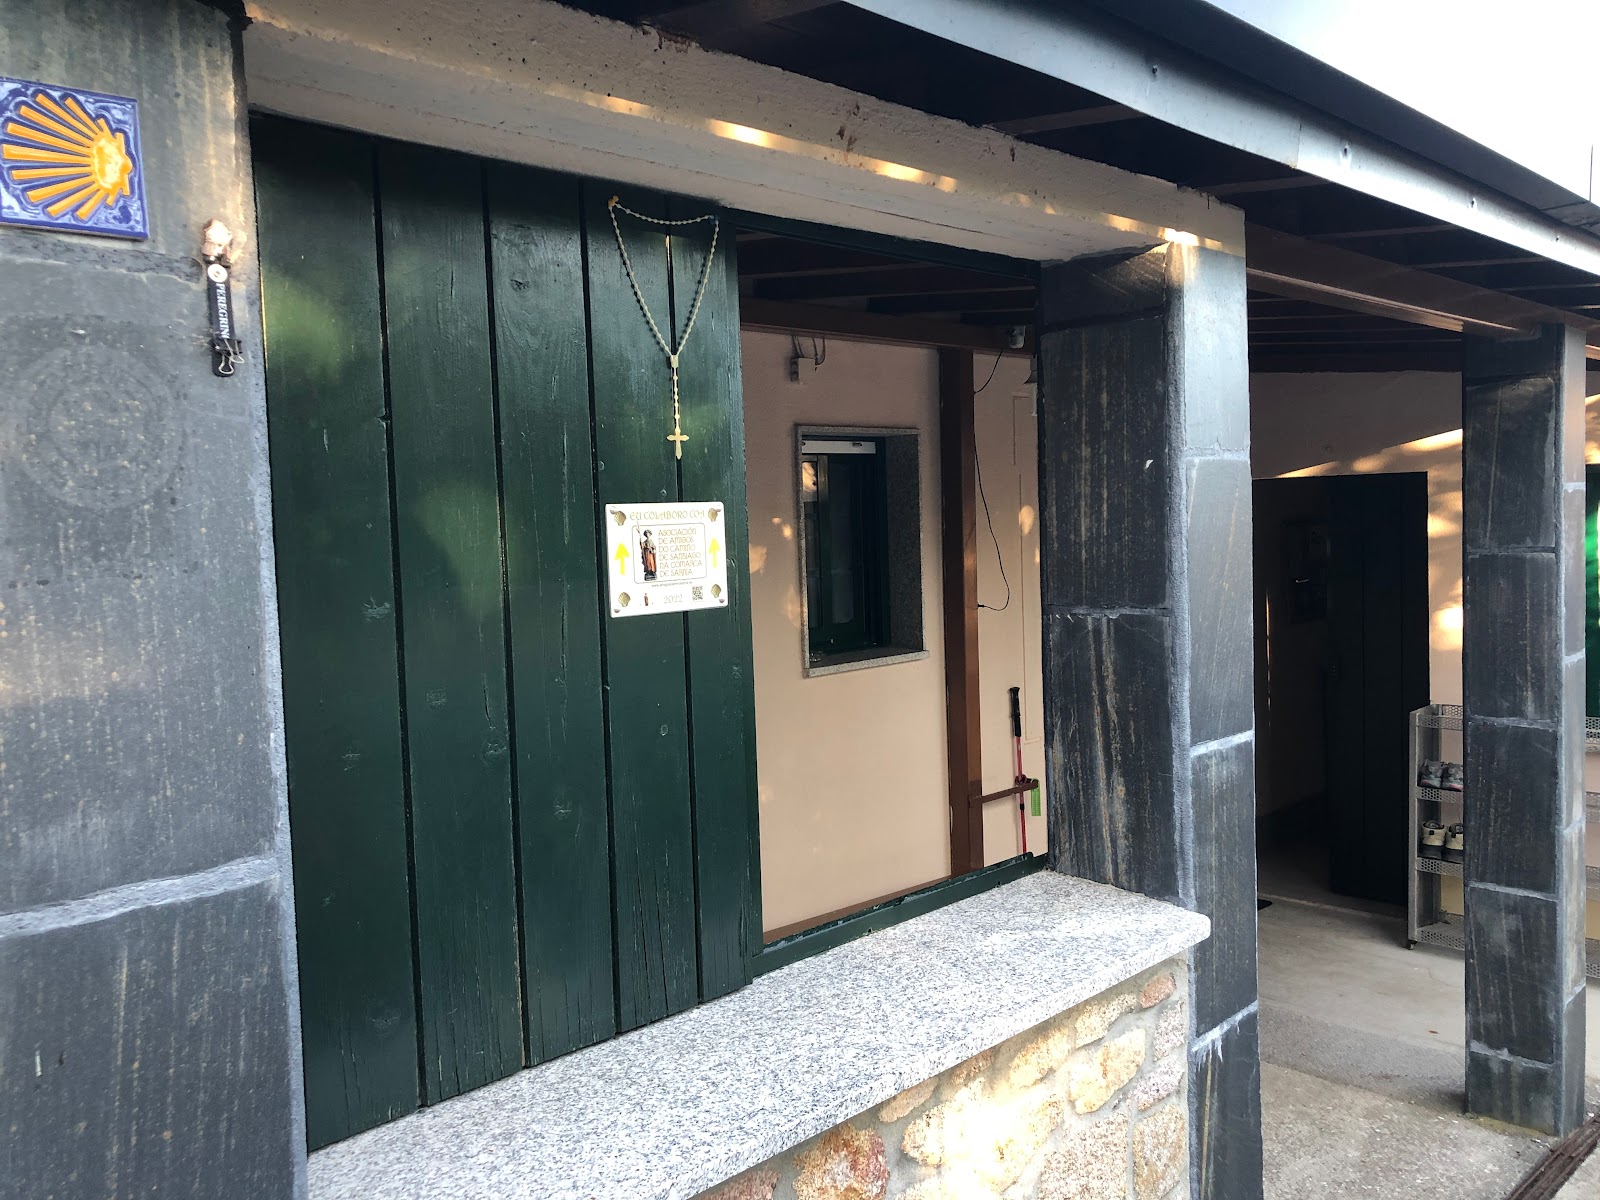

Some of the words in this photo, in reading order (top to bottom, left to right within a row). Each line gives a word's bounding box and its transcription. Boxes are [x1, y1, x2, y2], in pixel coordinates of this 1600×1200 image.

[643, 510, 687, 520] COLABORO
[670, 552, 701, 560] SANTIAGO
[671, 560, 702, 568] COMARCA
